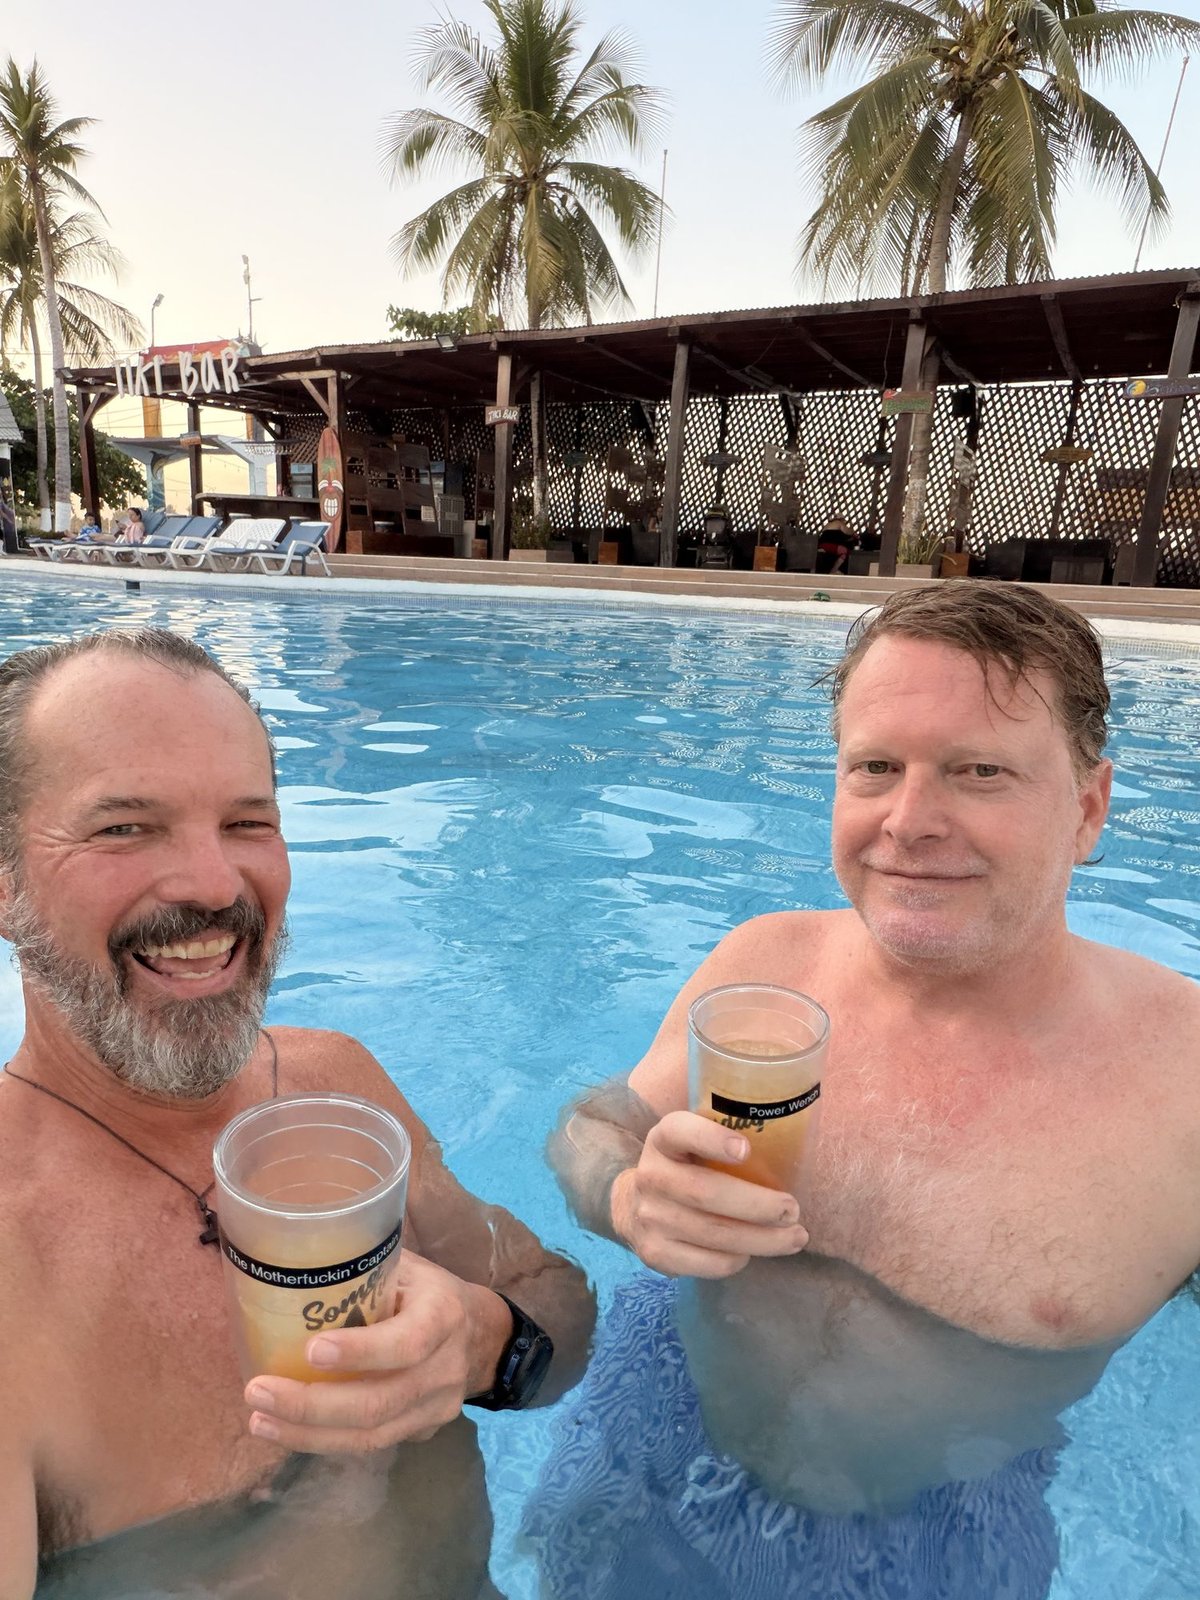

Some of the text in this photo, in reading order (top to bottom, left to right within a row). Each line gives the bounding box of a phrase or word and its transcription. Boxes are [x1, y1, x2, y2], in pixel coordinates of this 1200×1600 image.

[112, 353, 163, 399] TIKI
[749, 1089, 819, 1117] Power Wench
[227, 1233, 399, 1285] The Motherfuckin' Captain
